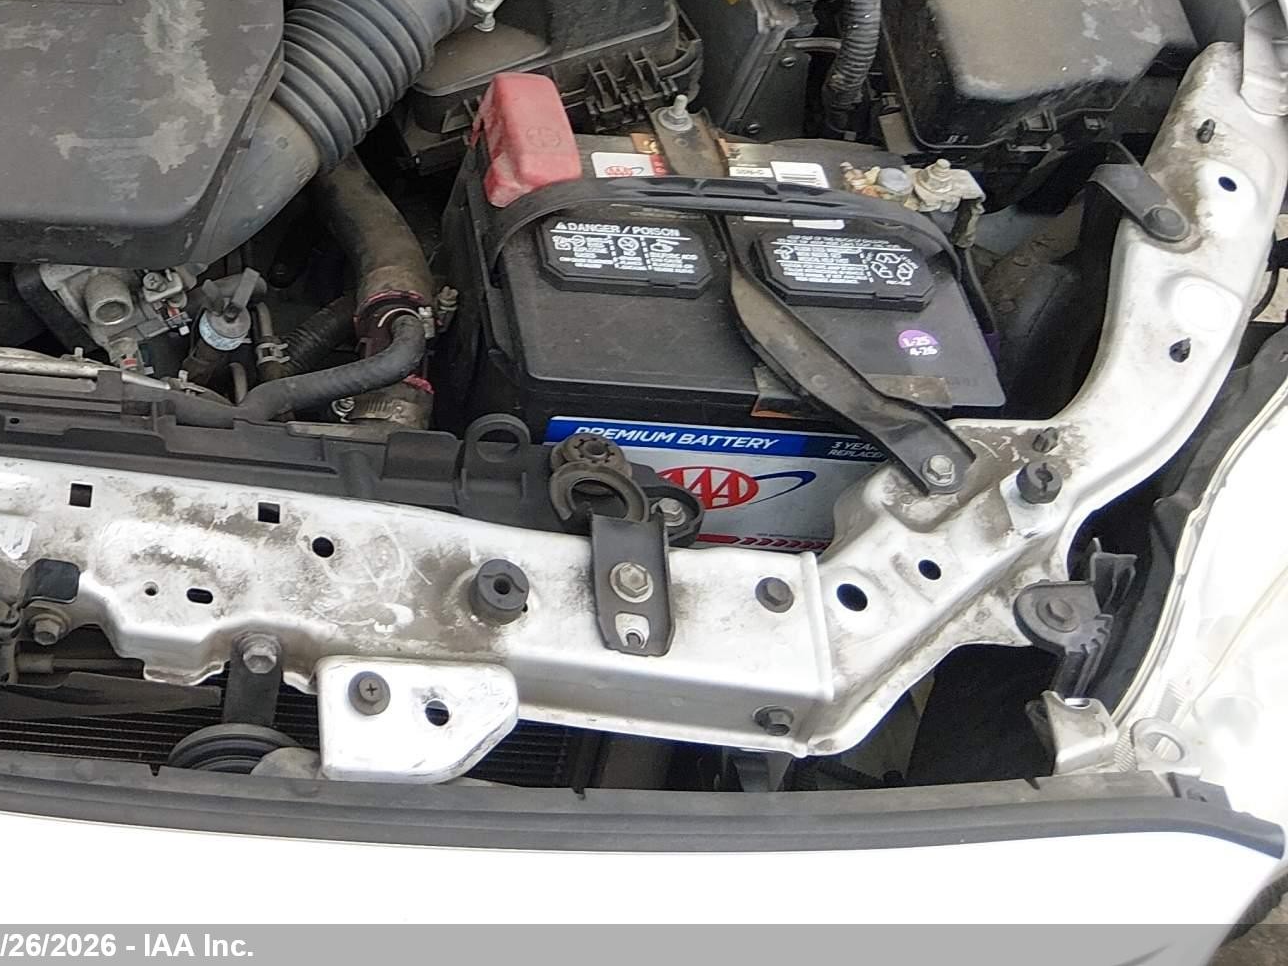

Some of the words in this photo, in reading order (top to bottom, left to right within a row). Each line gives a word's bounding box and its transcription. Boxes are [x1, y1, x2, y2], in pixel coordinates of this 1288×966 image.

[566, 222, 621, 234] DANGER
[632, 226, 681, 237] POISON
[677, 433, 780, 449] BATTERY
[831, 441, 843, 449] 3
